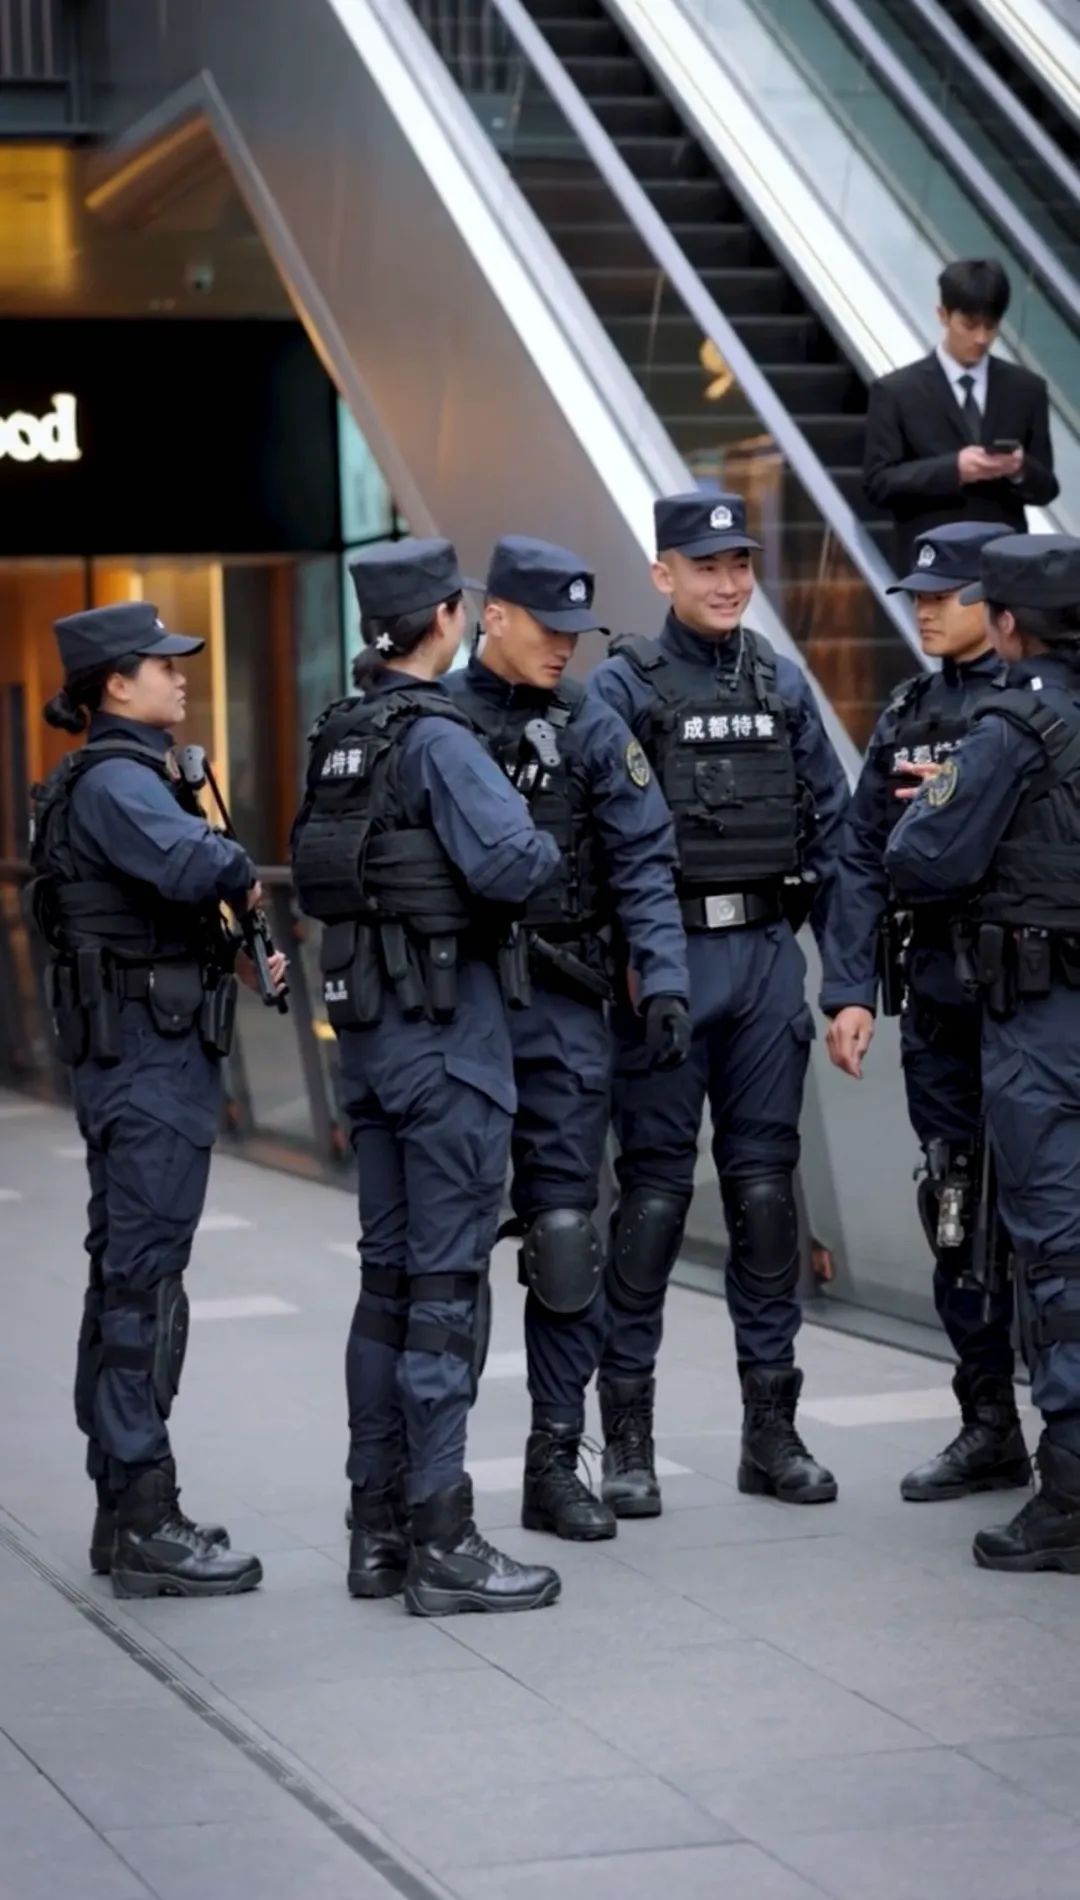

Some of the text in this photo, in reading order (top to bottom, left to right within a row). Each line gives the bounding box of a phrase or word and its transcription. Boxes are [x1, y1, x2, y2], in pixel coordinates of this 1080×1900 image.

[0, 392, 82, 461] od
[683, 714, 774, 739] 成都特警
